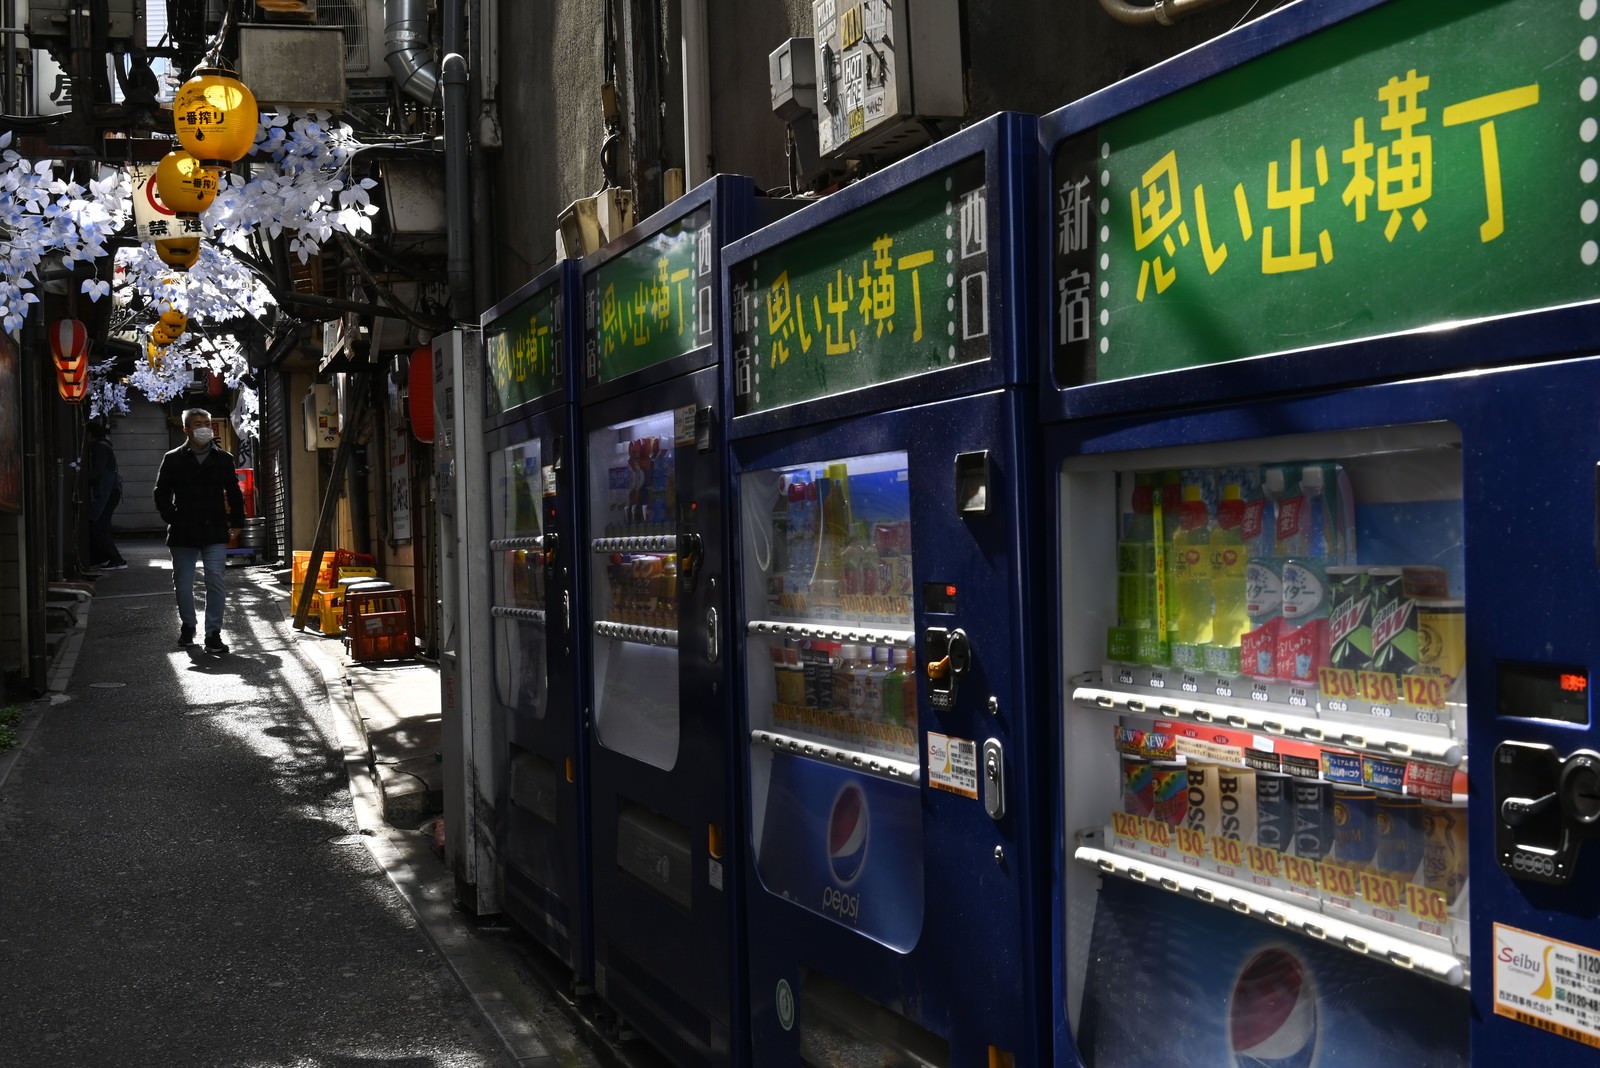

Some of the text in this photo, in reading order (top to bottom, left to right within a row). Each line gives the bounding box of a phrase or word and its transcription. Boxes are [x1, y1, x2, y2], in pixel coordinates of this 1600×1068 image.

[845, 54, 862, 84] HOT
[178, 112, 225, 125] 一番搾り
[182, 178, 217, 190] 一番搾り
[1130, 69, 1540, 302] 思い出横丁
[960, 184, 990, 341] 西口
[1057, 174, 1092, 345] 新宿
[601, 256, 689, 358] 思い出横丁
[766, 232, 934, 369] 思い出横丁
[1150, 679, 1164, 688] COLD
[1182, 683, 1197, 692] COLD
[1216, 687, 1231, 697] COLD
[1251, 691, 1268, 701] COLD
[1289, 696, 1307, 706] COLD
[1329, 702, 1347, 711] COLD
[1371, 707, 1391, 717] COLD
[1417, 713, 1438, 722] COLD
[1143, 734, 1166, 748] NEW
[1257, 780, 1281, 849] BLAC
[1295, 785, 1320, 858] BLAC
[822, 886, 859, 920] pepsi
[1498, 946, 1540, 973] Seibu
